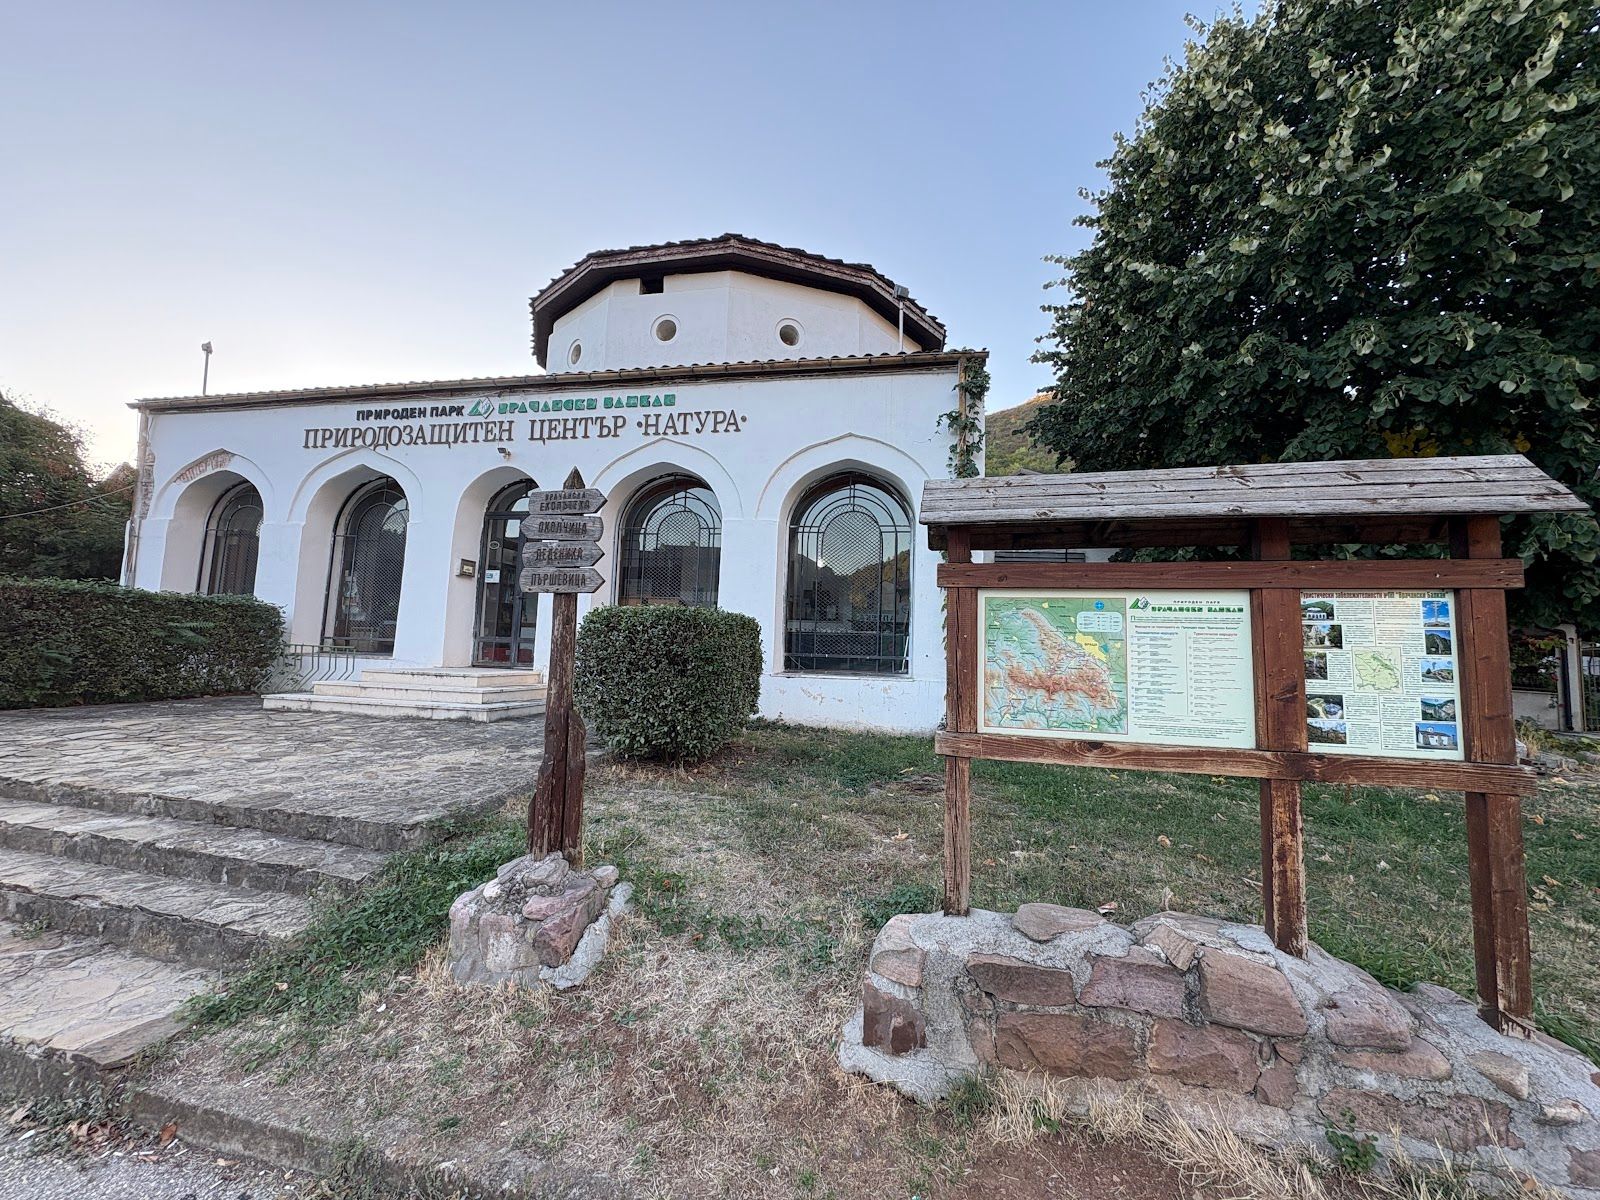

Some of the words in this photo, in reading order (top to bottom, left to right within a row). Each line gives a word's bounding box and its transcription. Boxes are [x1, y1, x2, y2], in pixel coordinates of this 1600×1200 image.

[497, 398, 598, 414] ВРАЧАНСКИ
[603, 393, 676, 408] БАЛКАН
[356, 406, 427, 421] ПРИРОДЕН
[429, 405, 465, 417] ПАРК
[302, 419, 516, 451] ПРИРОДОЗАЩИТЕН
[528, 415, 627, 445] ЦЕНТЪР
[540, 500, 590, 511] ЕКОПЪТЕКА
[538, 522, 587, 535] ОКОЛЧИЦА
[535, 548, 583, 561] ЛЕДЕНИКА
[530, 574, 586, 588] ПЪРШЕВИЦА
